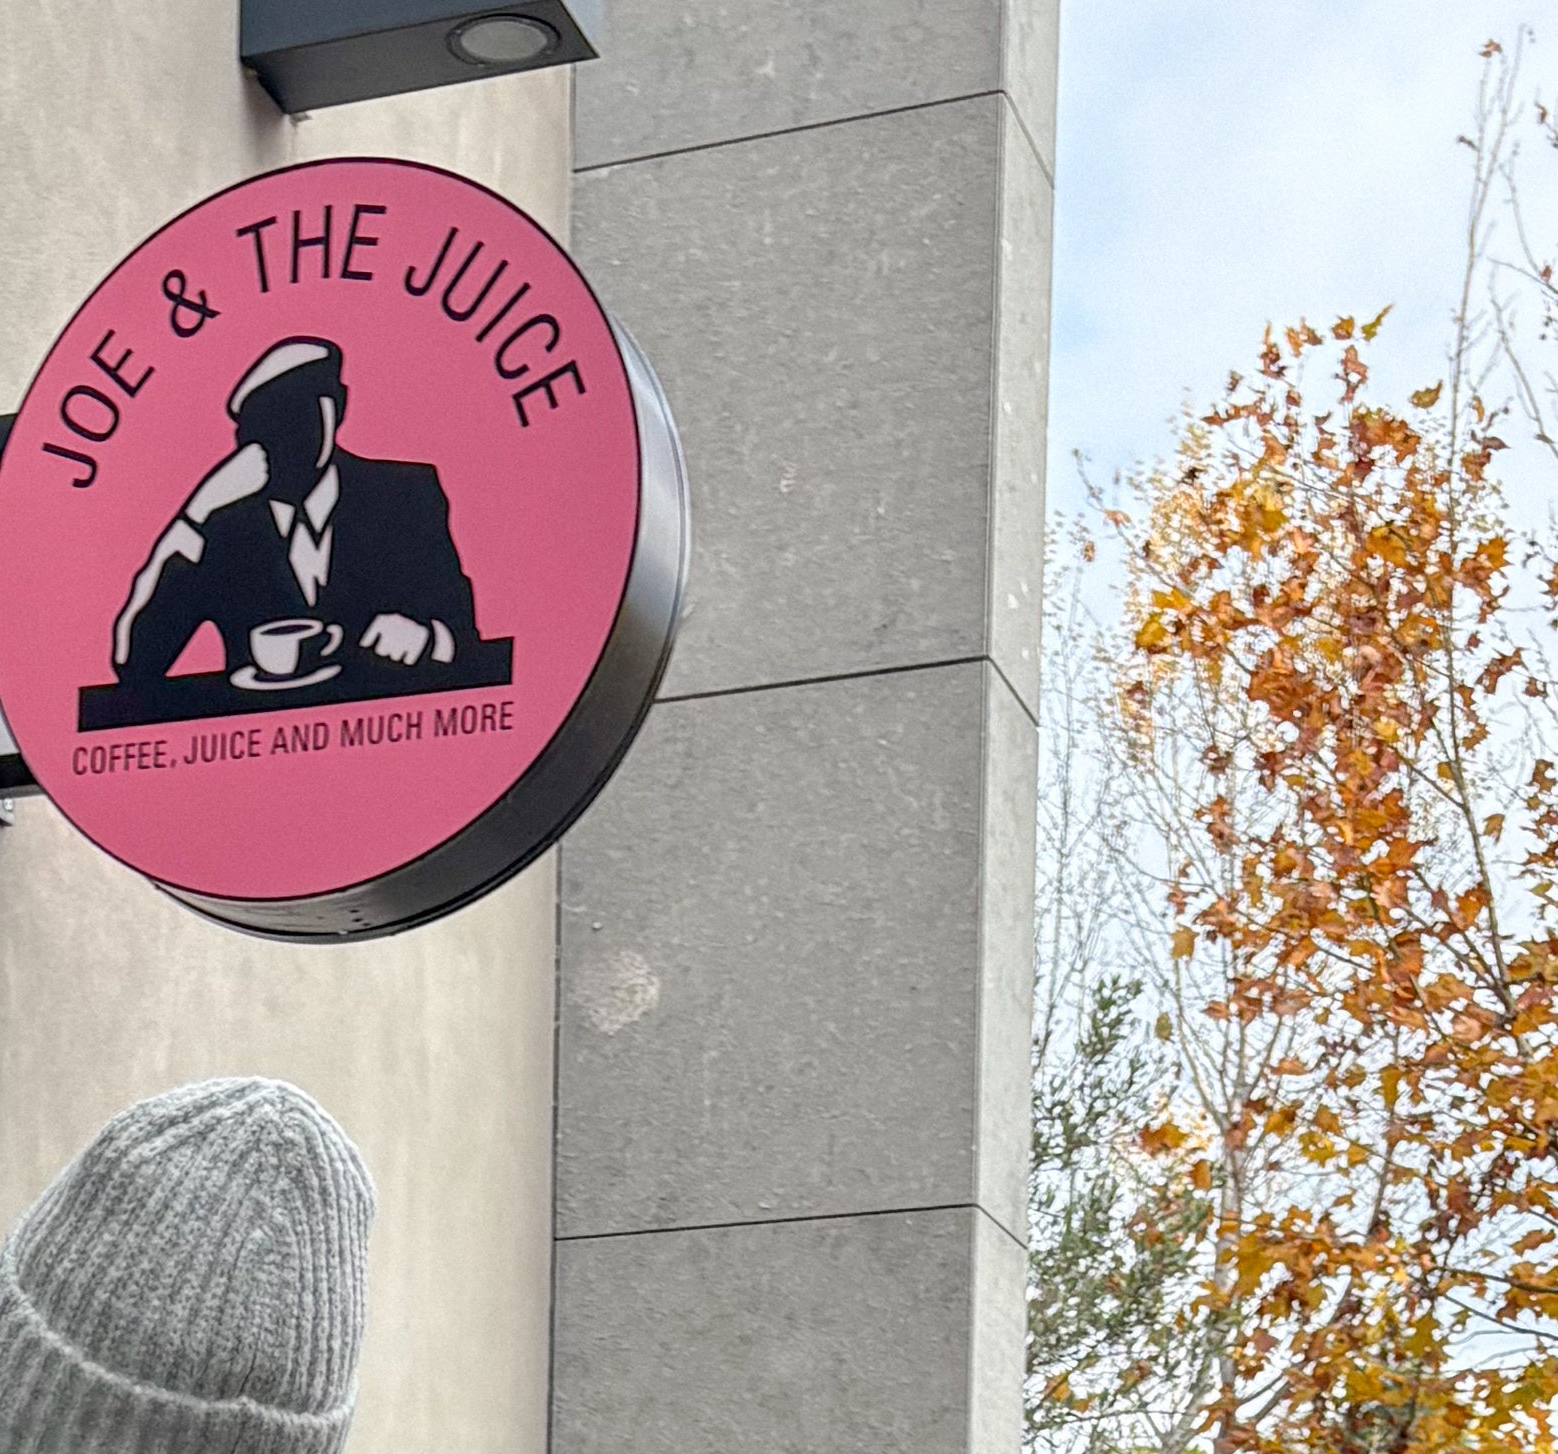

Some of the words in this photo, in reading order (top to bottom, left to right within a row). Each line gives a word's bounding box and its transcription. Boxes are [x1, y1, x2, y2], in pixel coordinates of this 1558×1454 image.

[42, 329, 155, 489] JOE
[161, 268, 221, 338] &
[235, 203, 387, 294] THE
[403, 225, 587, 428] JUICE
[72, 739, 177, 776] COFFEE,
[183, 728, 262, 765] JUICE
[269, 721, 330, 755] AND
[340, 710, 423, 748] MUCH
[433, 701, 515, 738] MORE
